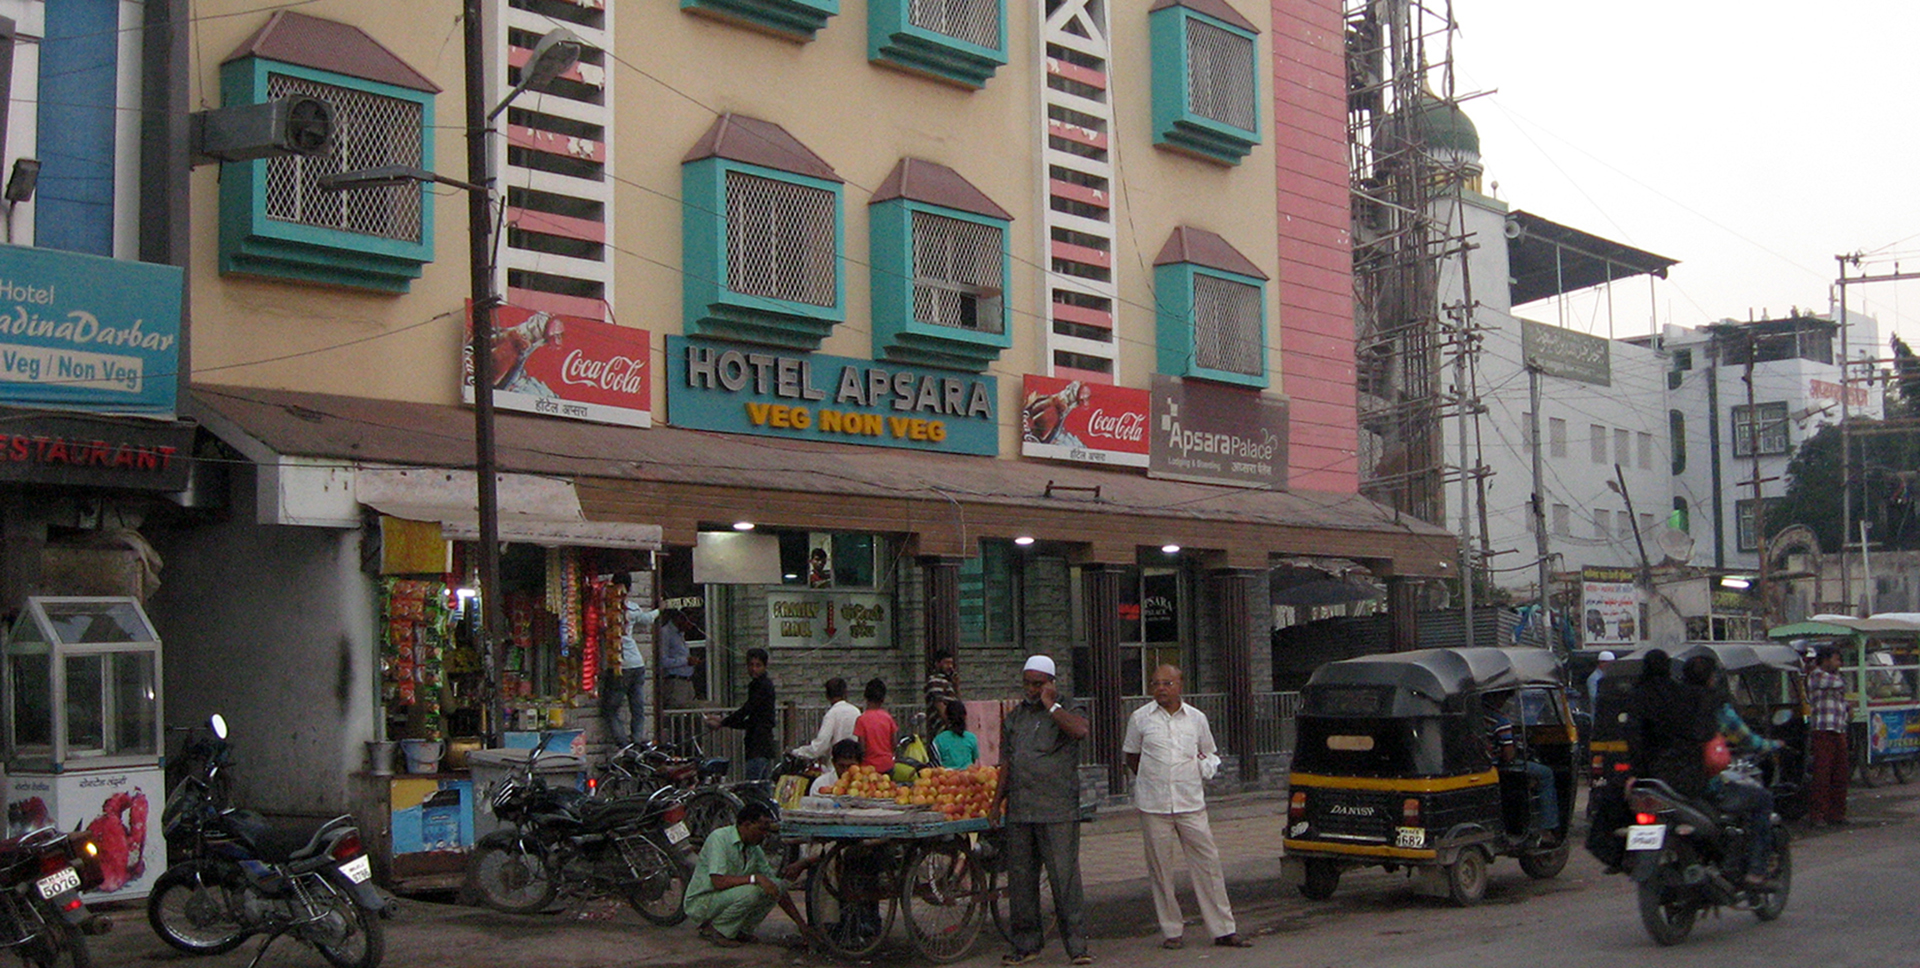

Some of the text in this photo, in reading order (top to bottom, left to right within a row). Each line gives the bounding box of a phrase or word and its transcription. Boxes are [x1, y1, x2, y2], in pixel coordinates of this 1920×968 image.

[0, 278, 55, 305] Hotel
[0, 306, 174, 351] adinaDarbar
[3, 350, 138, 390] Veg / Non Veg
[687, 345, 993, 418] HOTEL APSARA
[745, 401, 947, 442] VEG NON VEG
[0, 434, 177, 469] ESTAURANT
[43, 875, 79, 898] 5076
